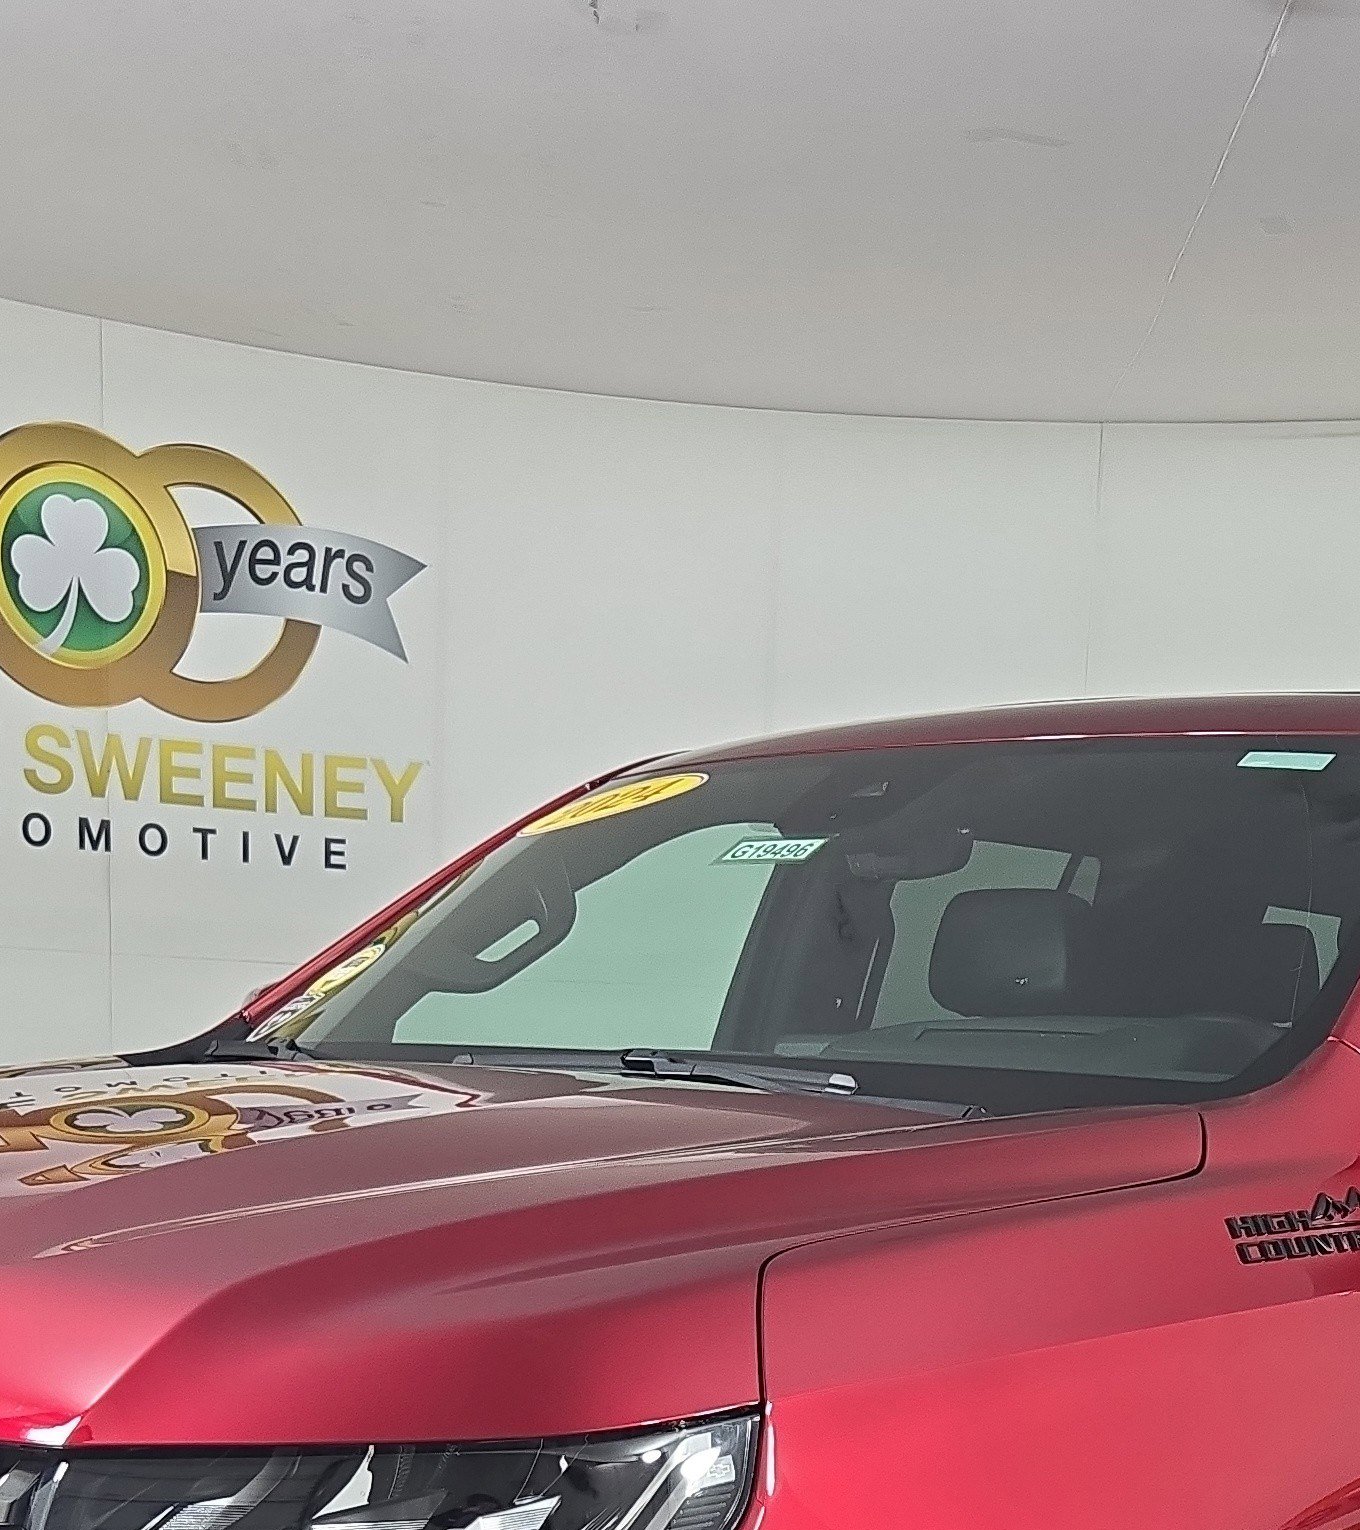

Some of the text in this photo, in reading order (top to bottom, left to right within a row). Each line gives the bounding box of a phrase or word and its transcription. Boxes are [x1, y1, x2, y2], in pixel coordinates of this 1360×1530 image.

[212, 538, 375, 605] years
[24, 725, 423, 823] SWEENEY
[731, 843, 814, 859] G19496
[1224, 1210, 1312, 1239] HIGH
